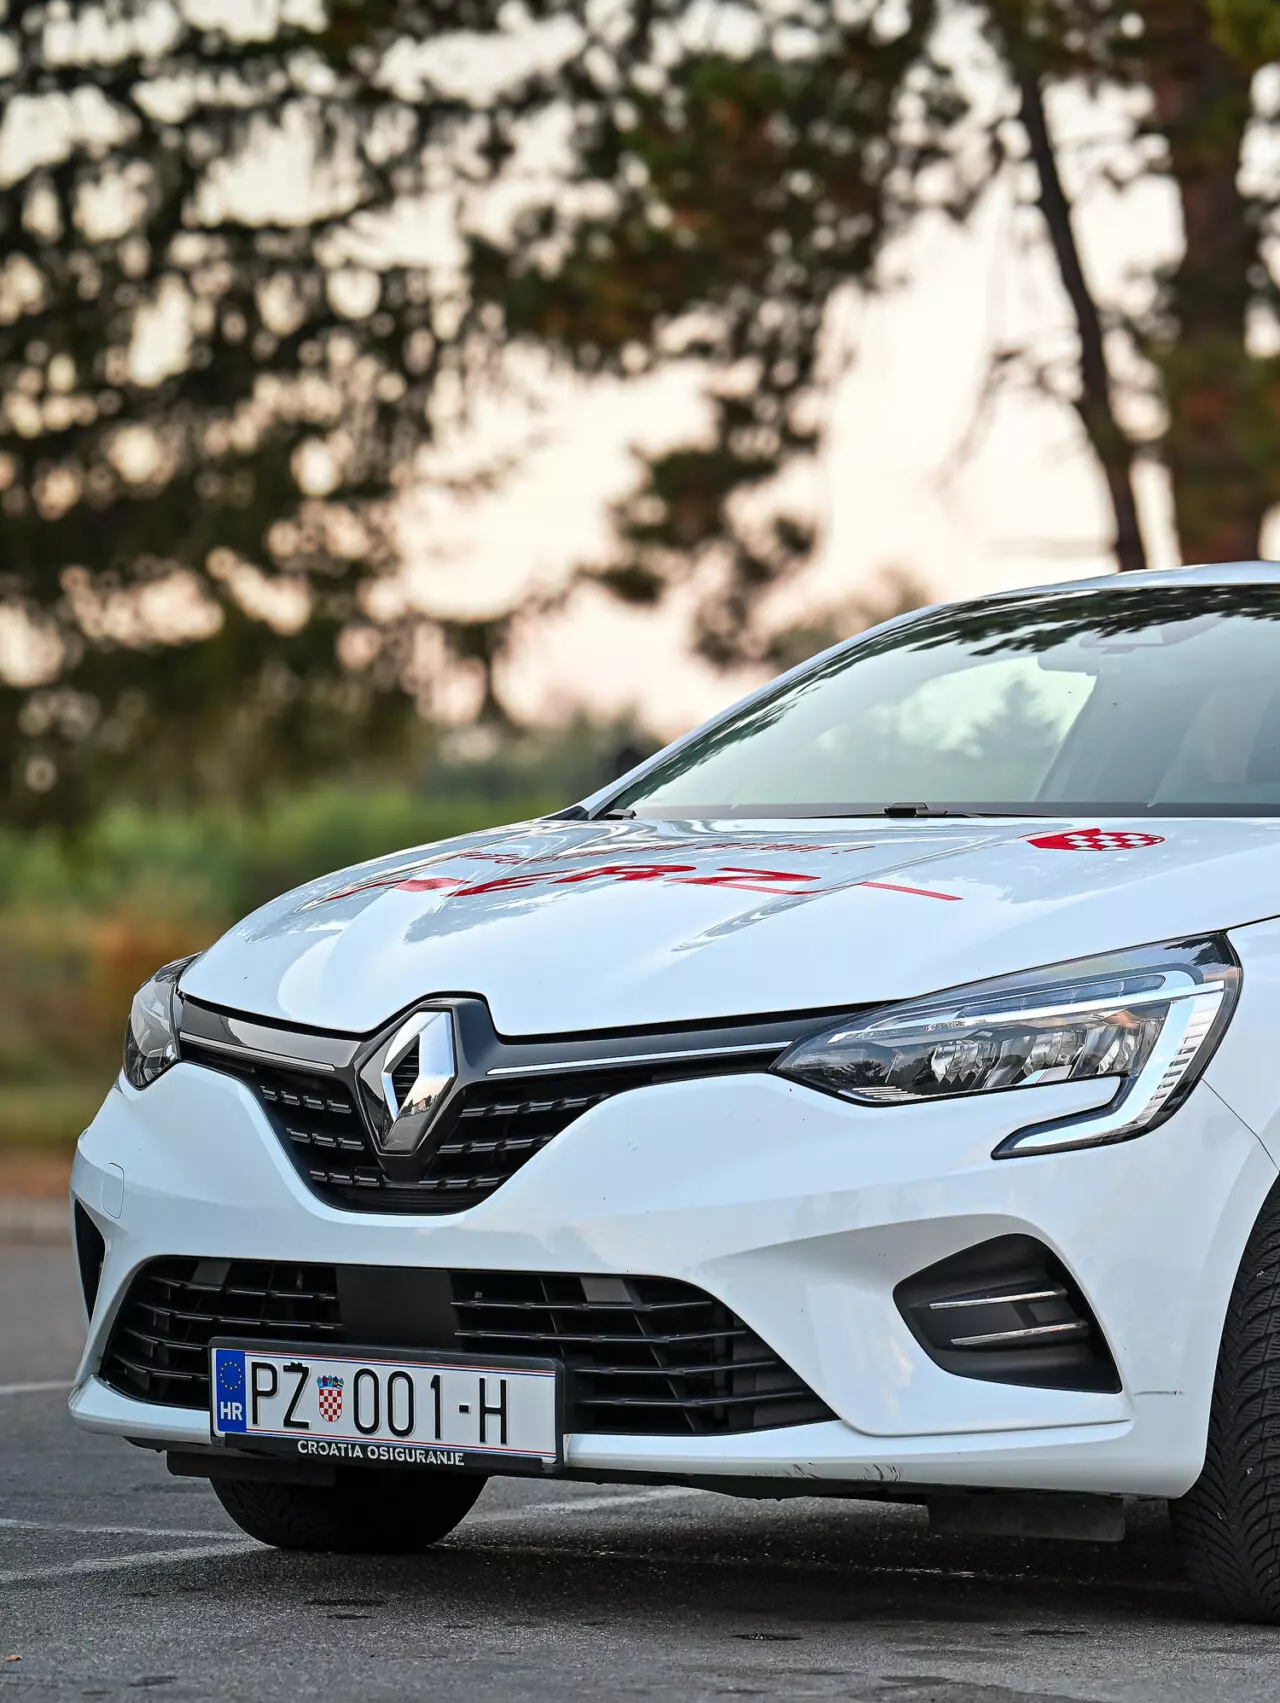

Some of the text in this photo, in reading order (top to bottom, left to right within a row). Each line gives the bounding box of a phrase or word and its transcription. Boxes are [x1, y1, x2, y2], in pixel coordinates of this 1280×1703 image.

[220, 1401, 243, 1421] HR
[251, 1361, 508, 1445] PŽ 001-H
[298, 1440, 465, 1466] CROATIA OSIGURANJE
